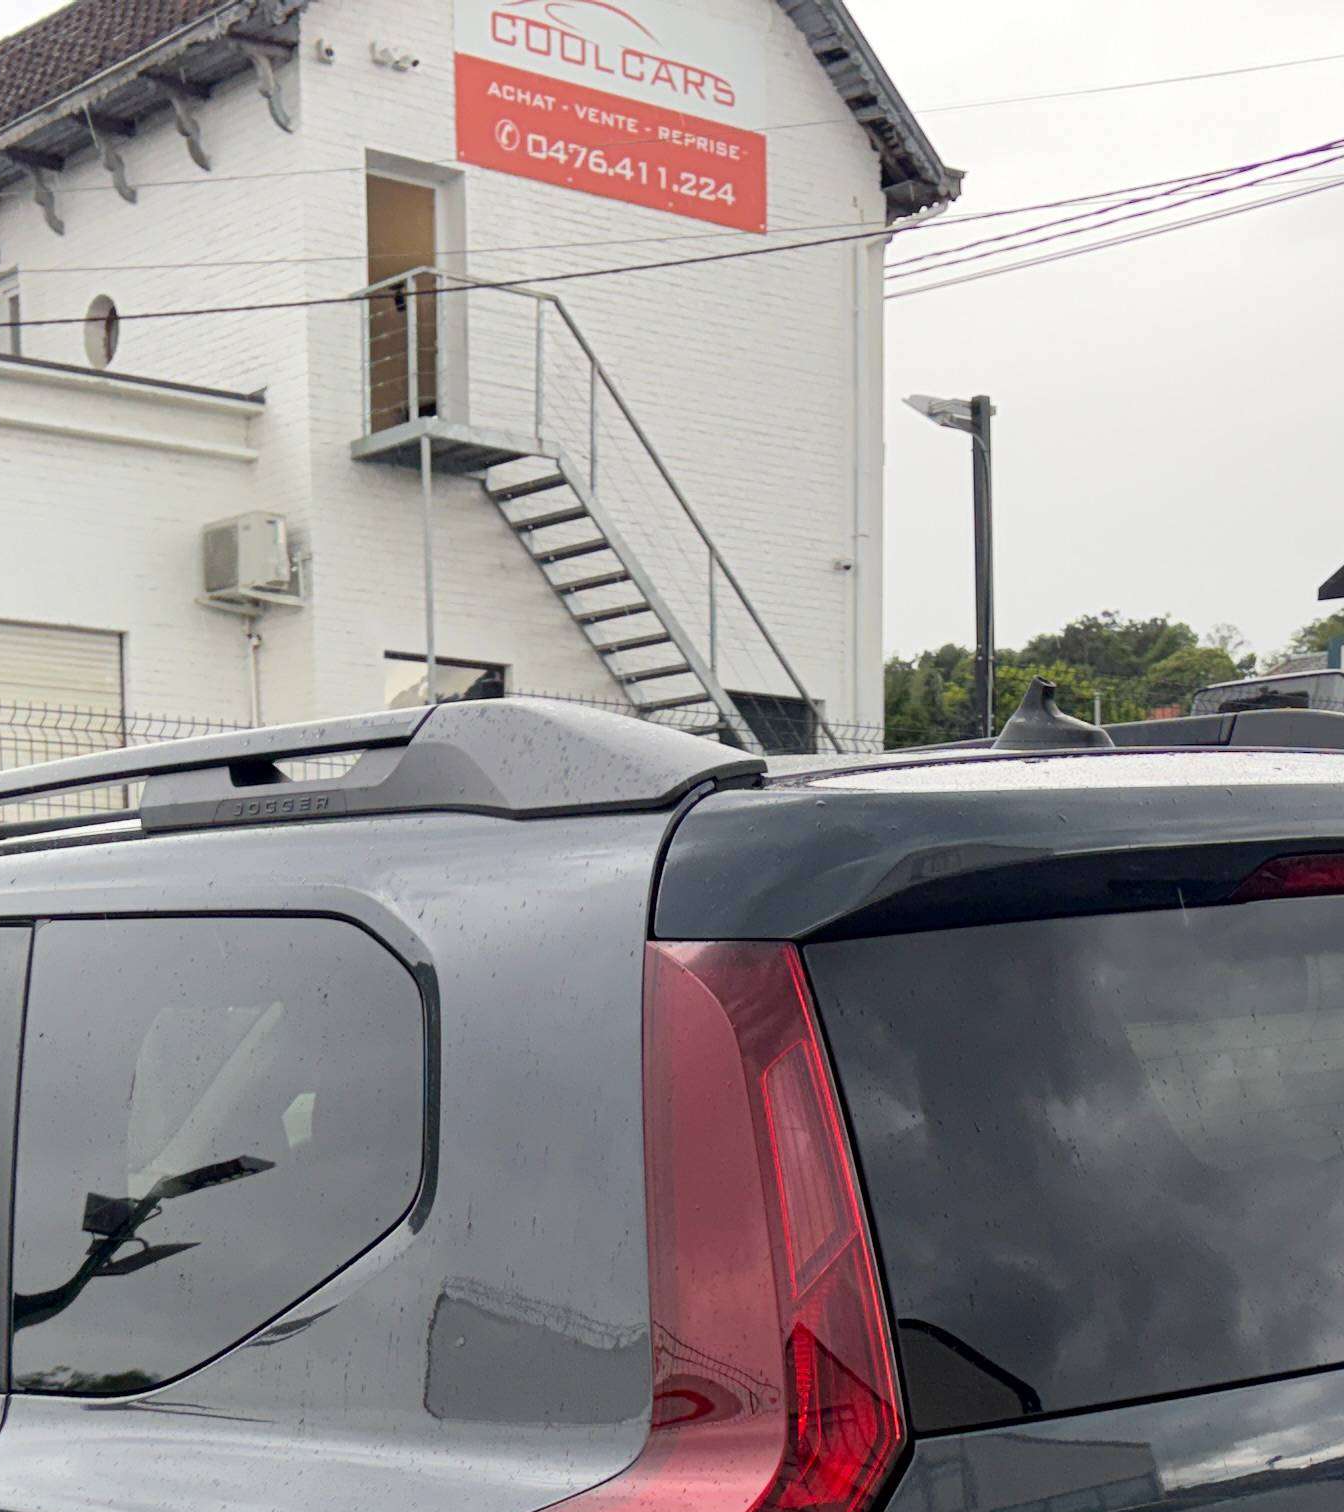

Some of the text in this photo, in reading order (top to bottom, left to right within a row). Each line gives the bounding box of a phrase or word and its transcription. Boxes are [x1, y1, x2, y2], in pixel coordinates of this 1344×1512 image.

[487, 81, 556, 113] ACHAT
[575, 104, 639, 135] VENTE
[658, 126, 740, 161] REPRISE
[527, 133, 736, 206] 0476.411.224
[233, 797, 330, 817] JOGGER
